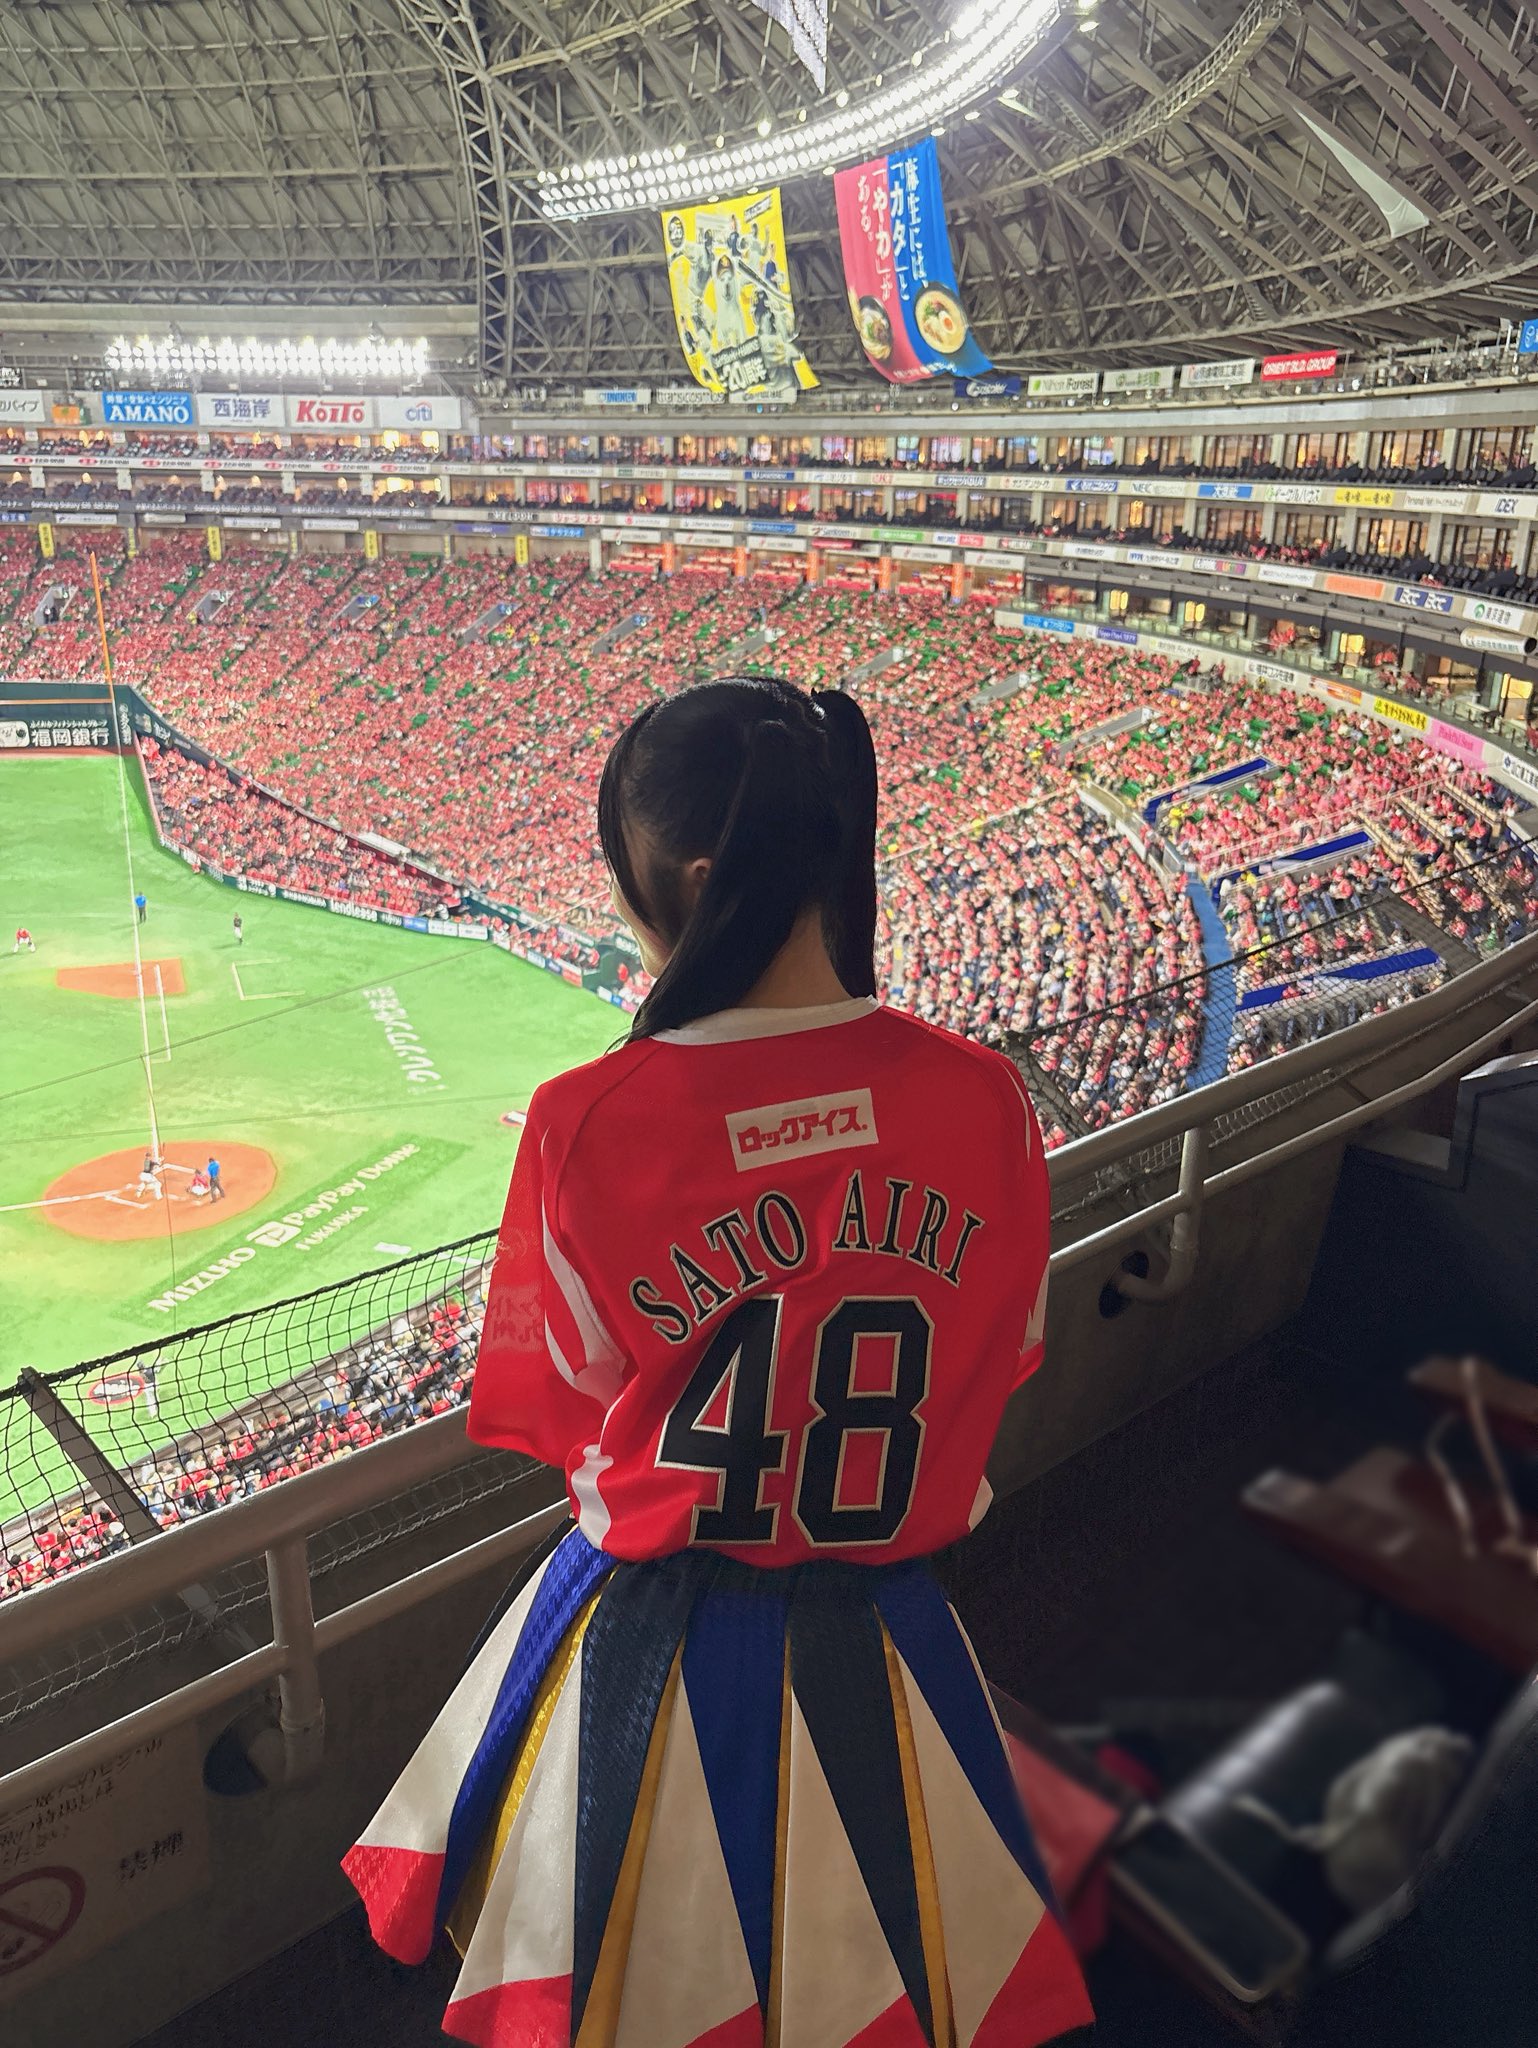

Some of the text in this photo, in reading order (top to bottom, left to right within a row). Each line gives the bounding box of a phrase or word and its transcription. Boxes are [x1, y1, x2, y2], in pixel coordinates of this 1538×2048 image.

[110, 404, 190, 424] AMANO
[212, 397, 271, 418] 西海岸
[30, 727, 110, 747] 福岡銀行
[149, 1246, 256, 1313] MIZUHO
[282, 1178, 366, 1226] PayPay
[628, 1169, 986, 1345] SATO AIRI
[654, 1293, 936, 1549] 48
